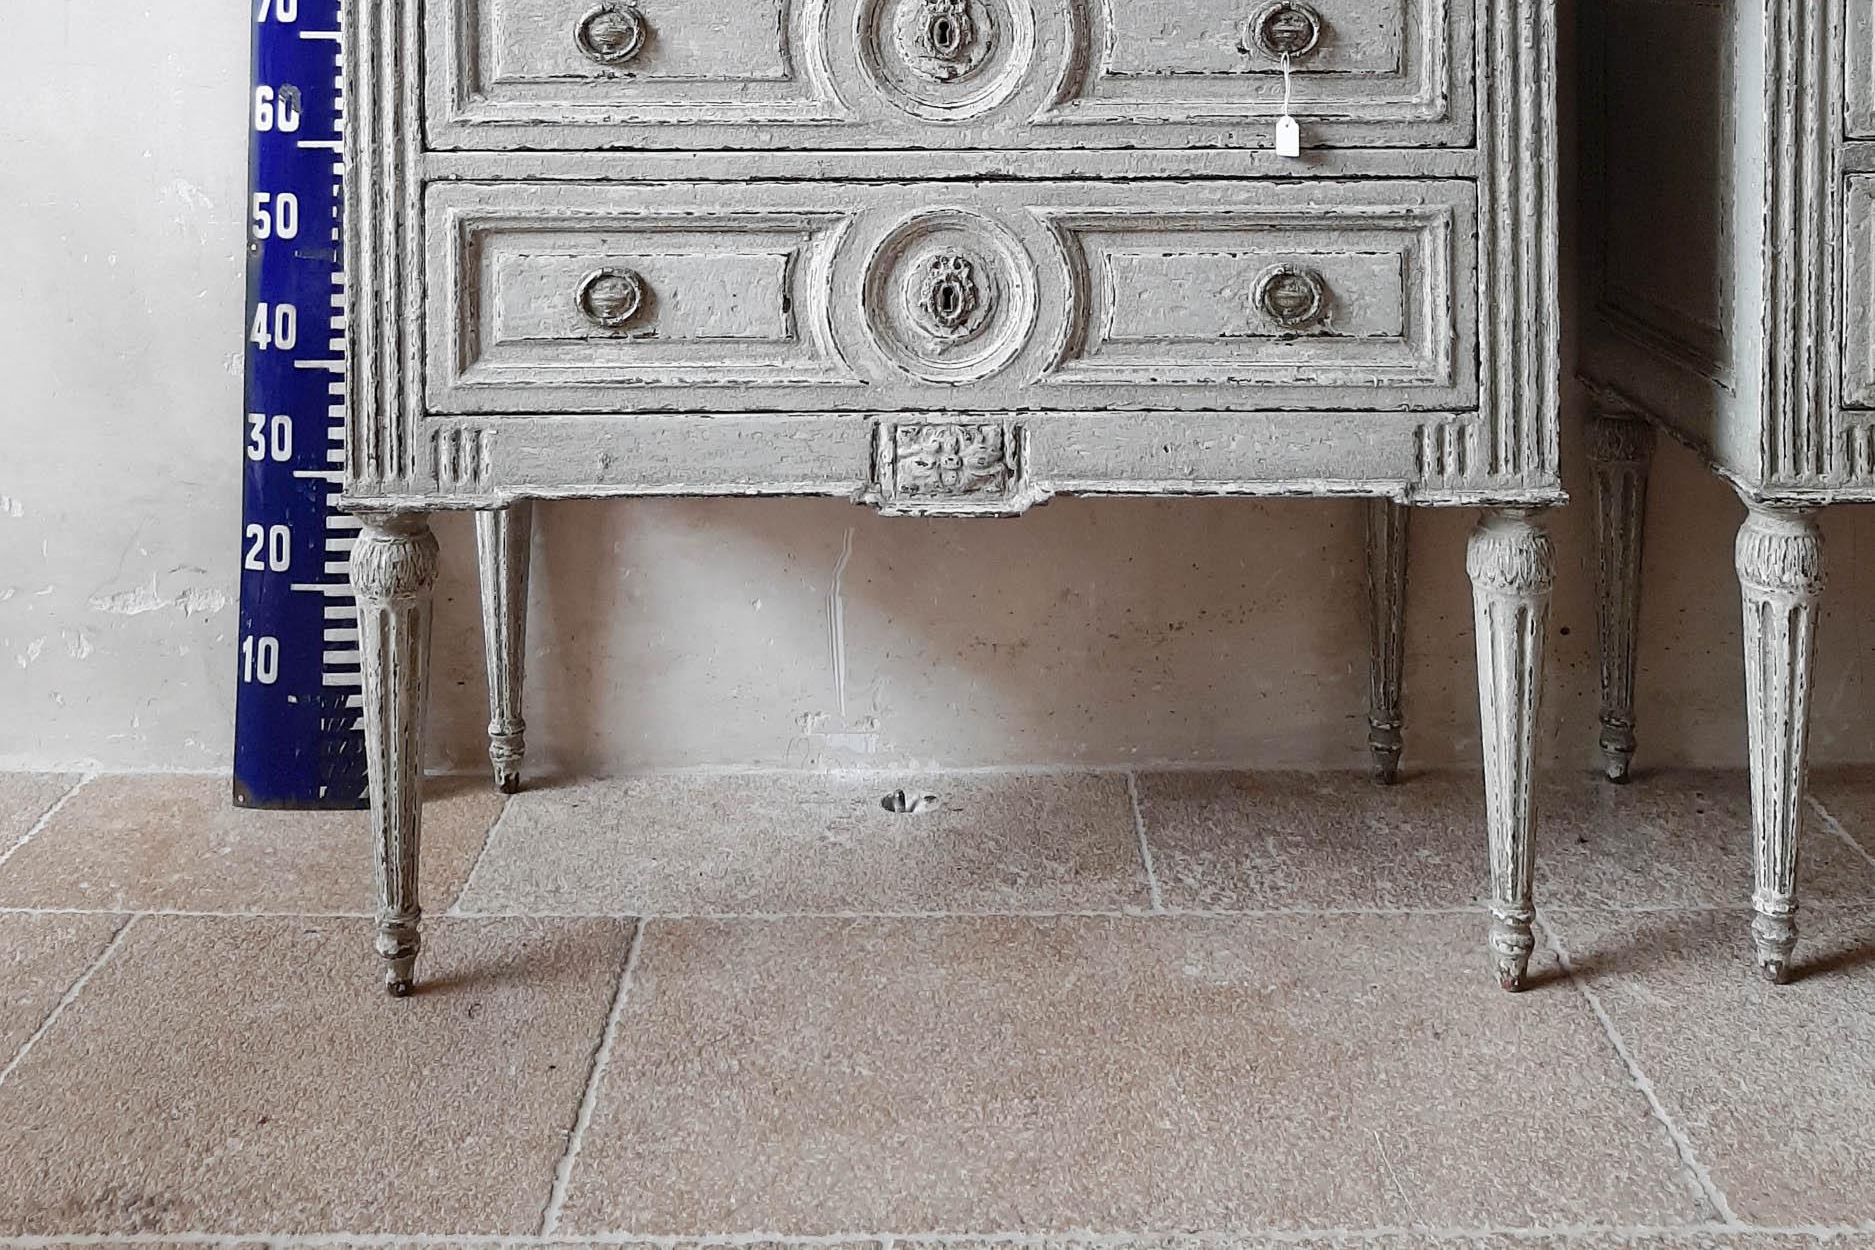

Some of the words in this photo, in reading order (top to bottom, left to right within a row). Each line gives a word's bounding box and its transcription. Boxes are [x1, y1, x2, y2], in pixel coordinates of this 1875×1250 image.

[255, 83, 302, 132] 60
[251, 192, 298, 240] 50
[249, 302, 297, 350] 40
[247, 414, 293, 461] 30
[244, 524, 291, 571] 20
[242, 636, 279, 684] 10
